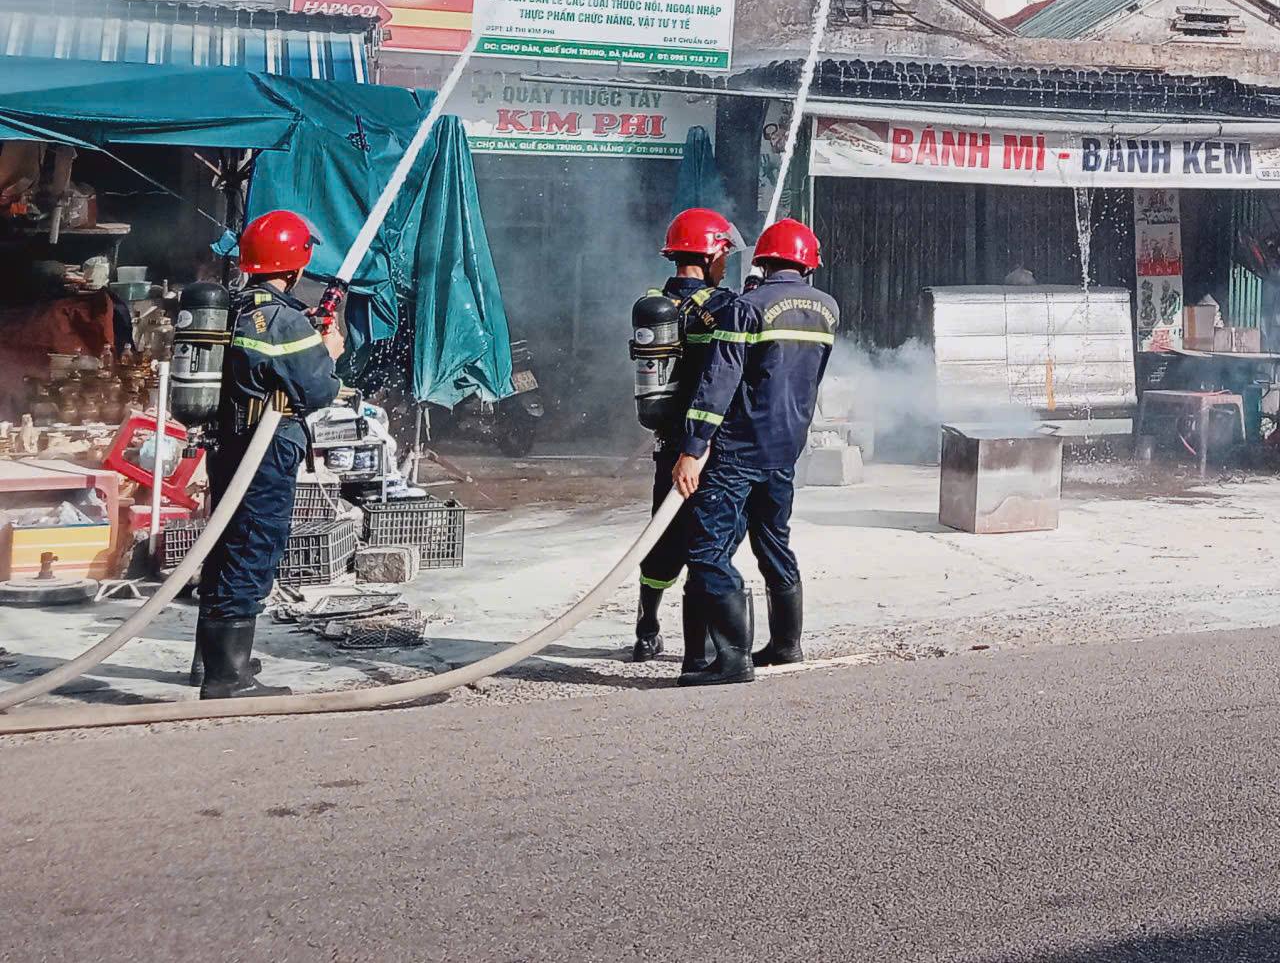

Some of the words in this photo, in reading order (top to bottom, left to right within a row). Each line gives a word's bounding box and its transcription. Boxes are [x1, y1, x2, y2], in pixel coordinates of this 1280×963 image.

[671, 18, 677, 29] Y
[501, 43, 520, 53] CHỢ
[496, 108, 582, 135] KIM
[592, 112, 667, 138] PHI
[476, 140, 496, 150] CHỢ
[537, 142, 555, 150] SƠN
[891, 124, 991, 169] BÁNH
[1003, 132, 1046, 171] MÌ
[1058, 152, 1071, 160] -
[1183, 139, 1252, 175] KEM
